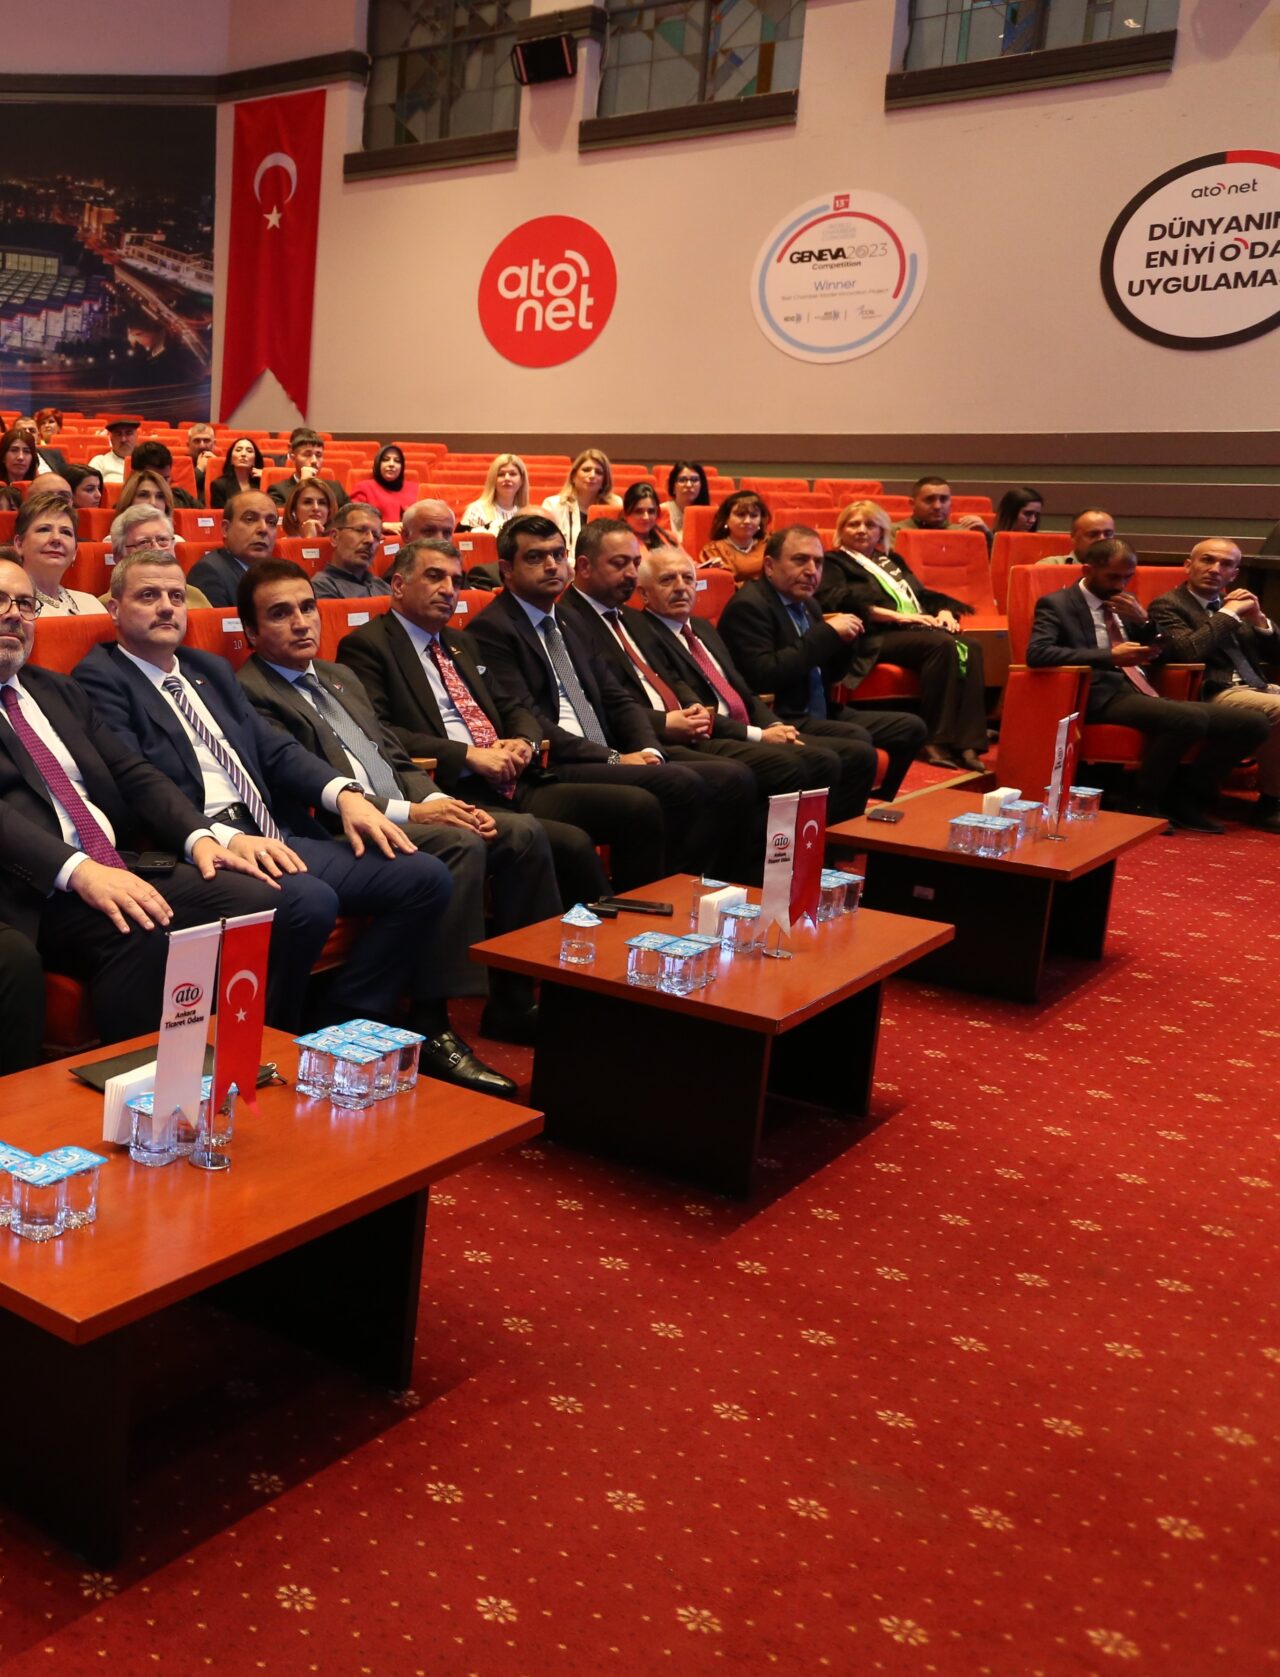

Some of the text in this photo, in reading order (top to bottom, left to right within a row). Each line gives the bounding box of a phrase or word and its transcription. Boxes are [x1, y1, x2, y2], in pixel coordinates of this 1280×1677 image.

[1145, 250, 1179, 268] EN
[1183, 242, 1215, 265] İYİ
[812, 261, 862, 271] Competition
[498, 258, 577, 299] ato
[814, 280, 856, 291] Winner
[515, 284, 594, 332] net
[176, 987, 199, 1003] ato
[175, 1010, 196, 1019] Ankara
[165, 1020, 185, 1028] Ticaret
